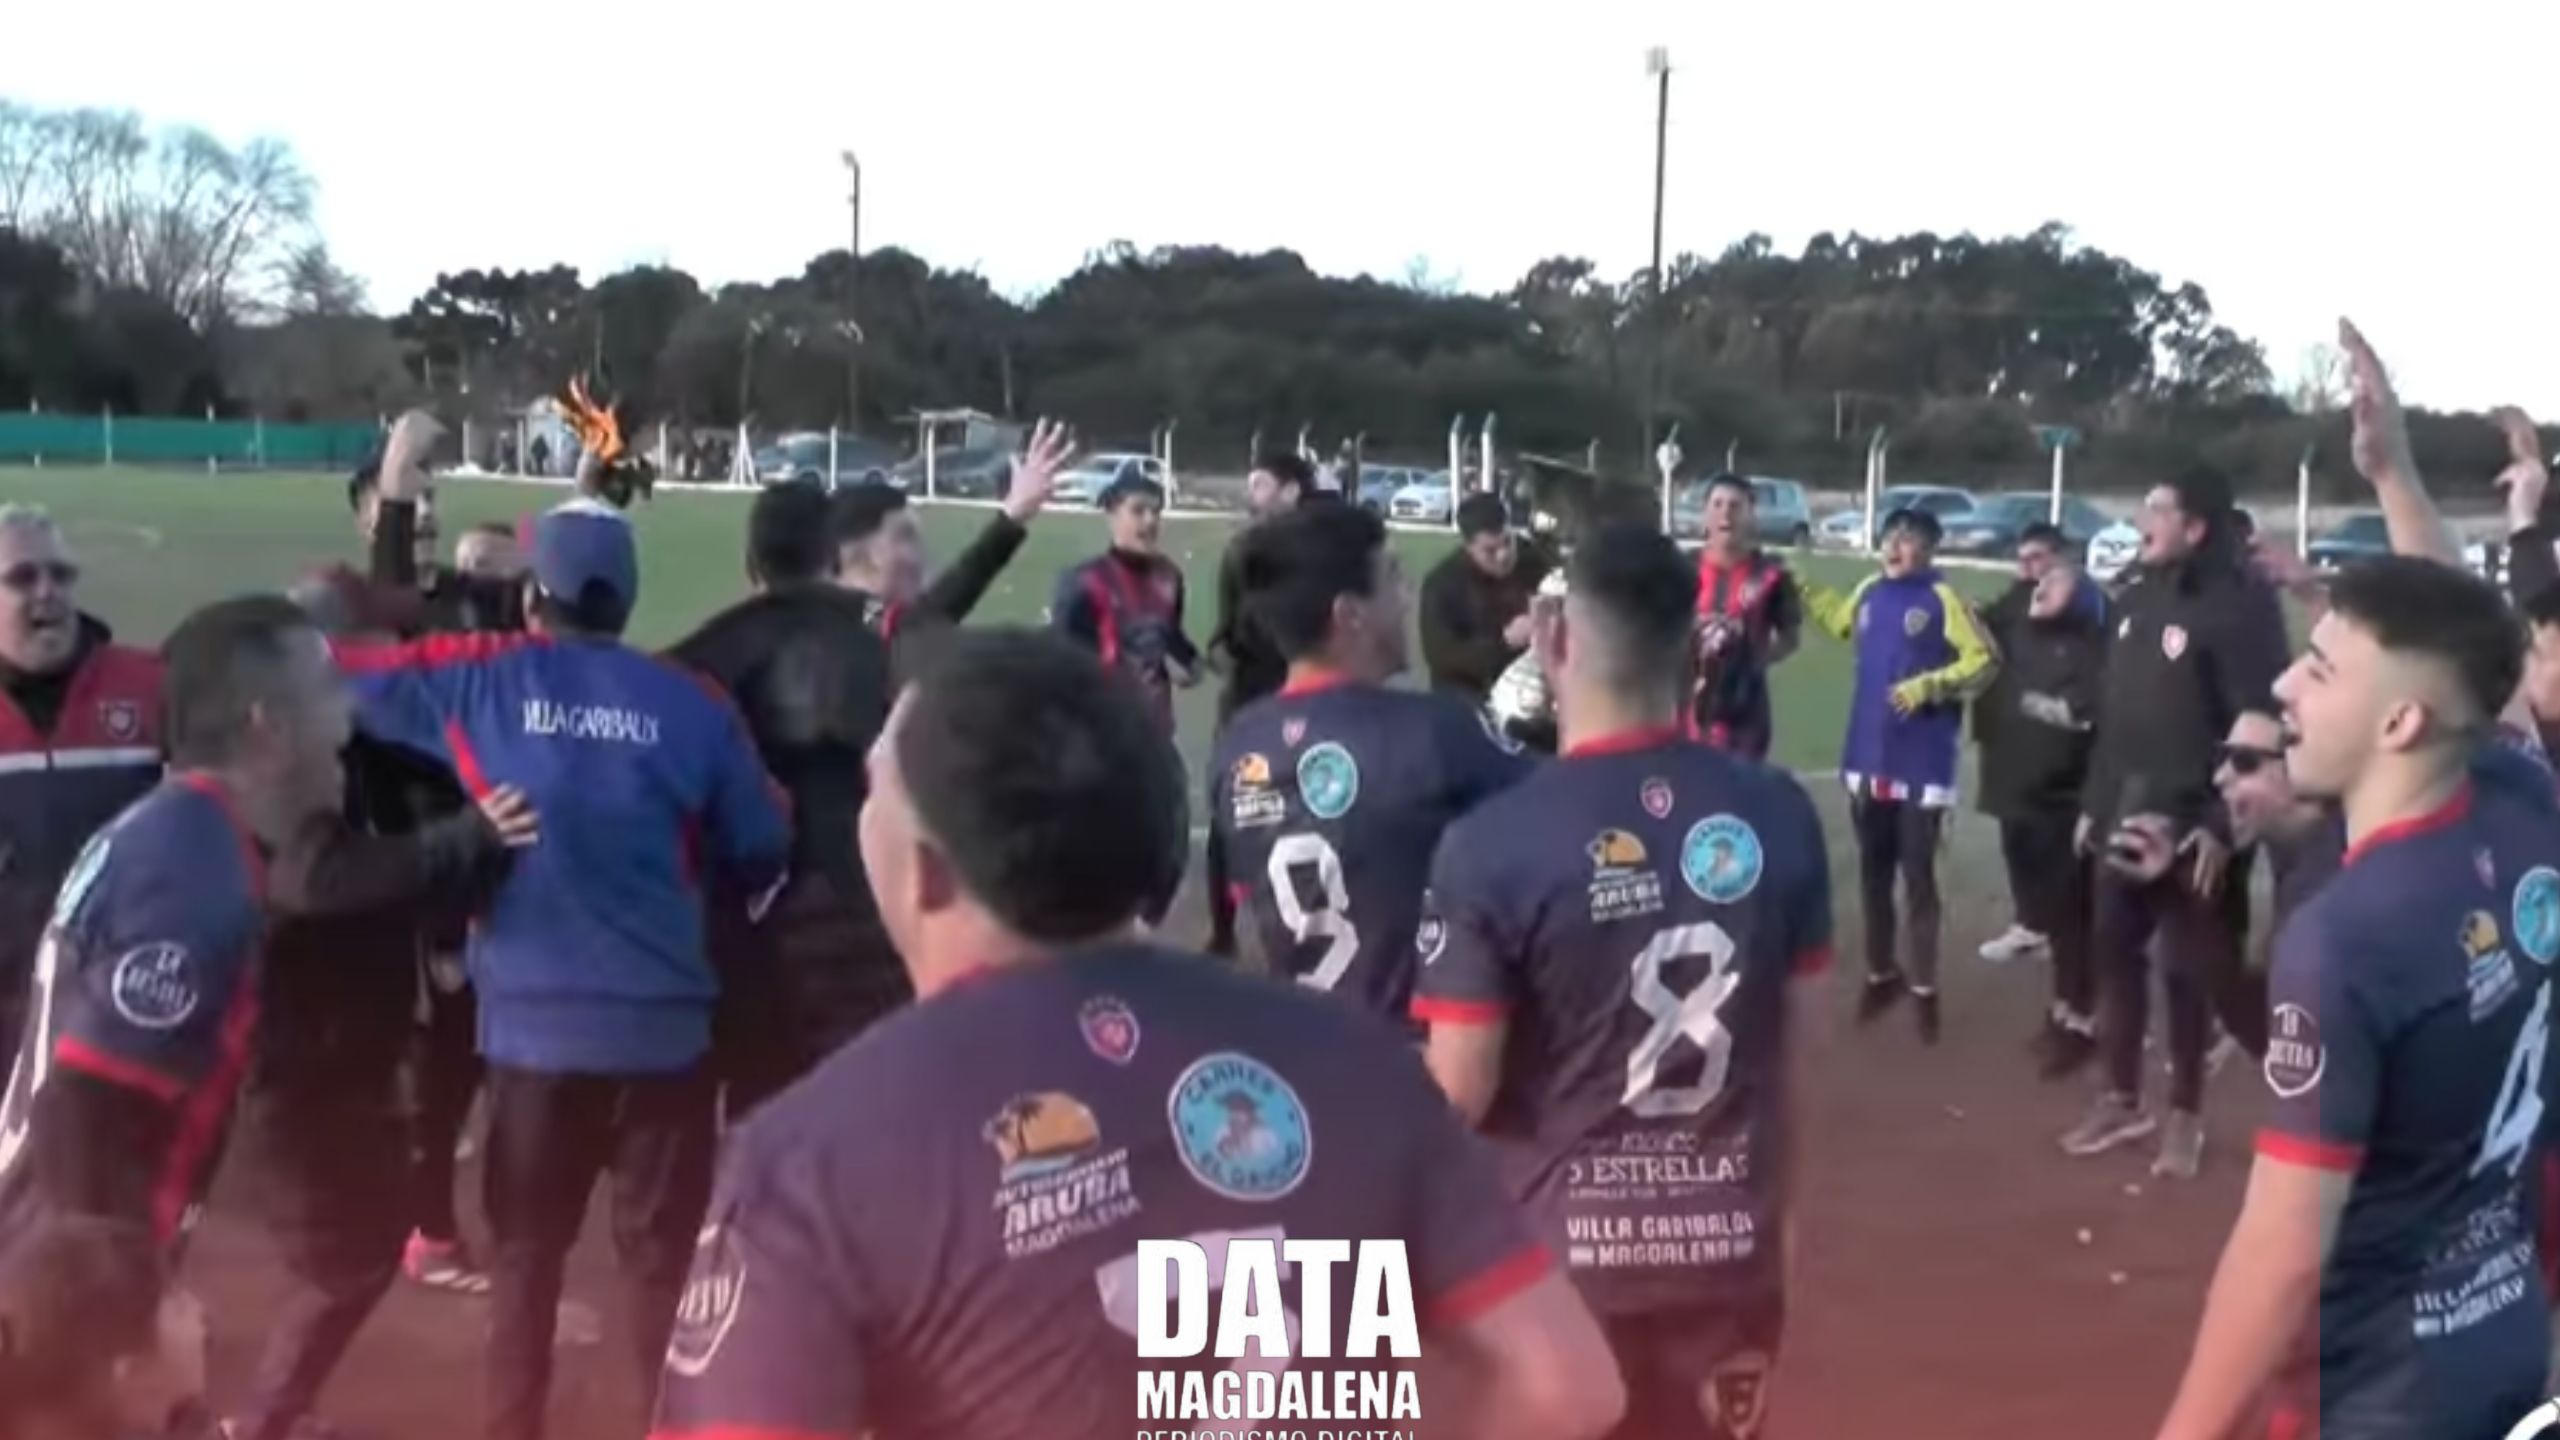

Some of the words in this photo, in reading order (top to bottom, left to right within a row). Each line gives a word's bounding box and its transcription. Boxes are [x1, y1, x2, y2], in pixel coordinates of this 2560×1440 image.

[1268, 832, 1359, 991] 9
[1620, 921, 1740, 1118] 8
[2468, 978, 2551, 1177] 4
[1592, 1154, 1748, 1184] ESTRELLAS
[1567, 1216, 1632, 1239] VILLA
[1599, 1240, 1731, 1266] MAGDALENA
